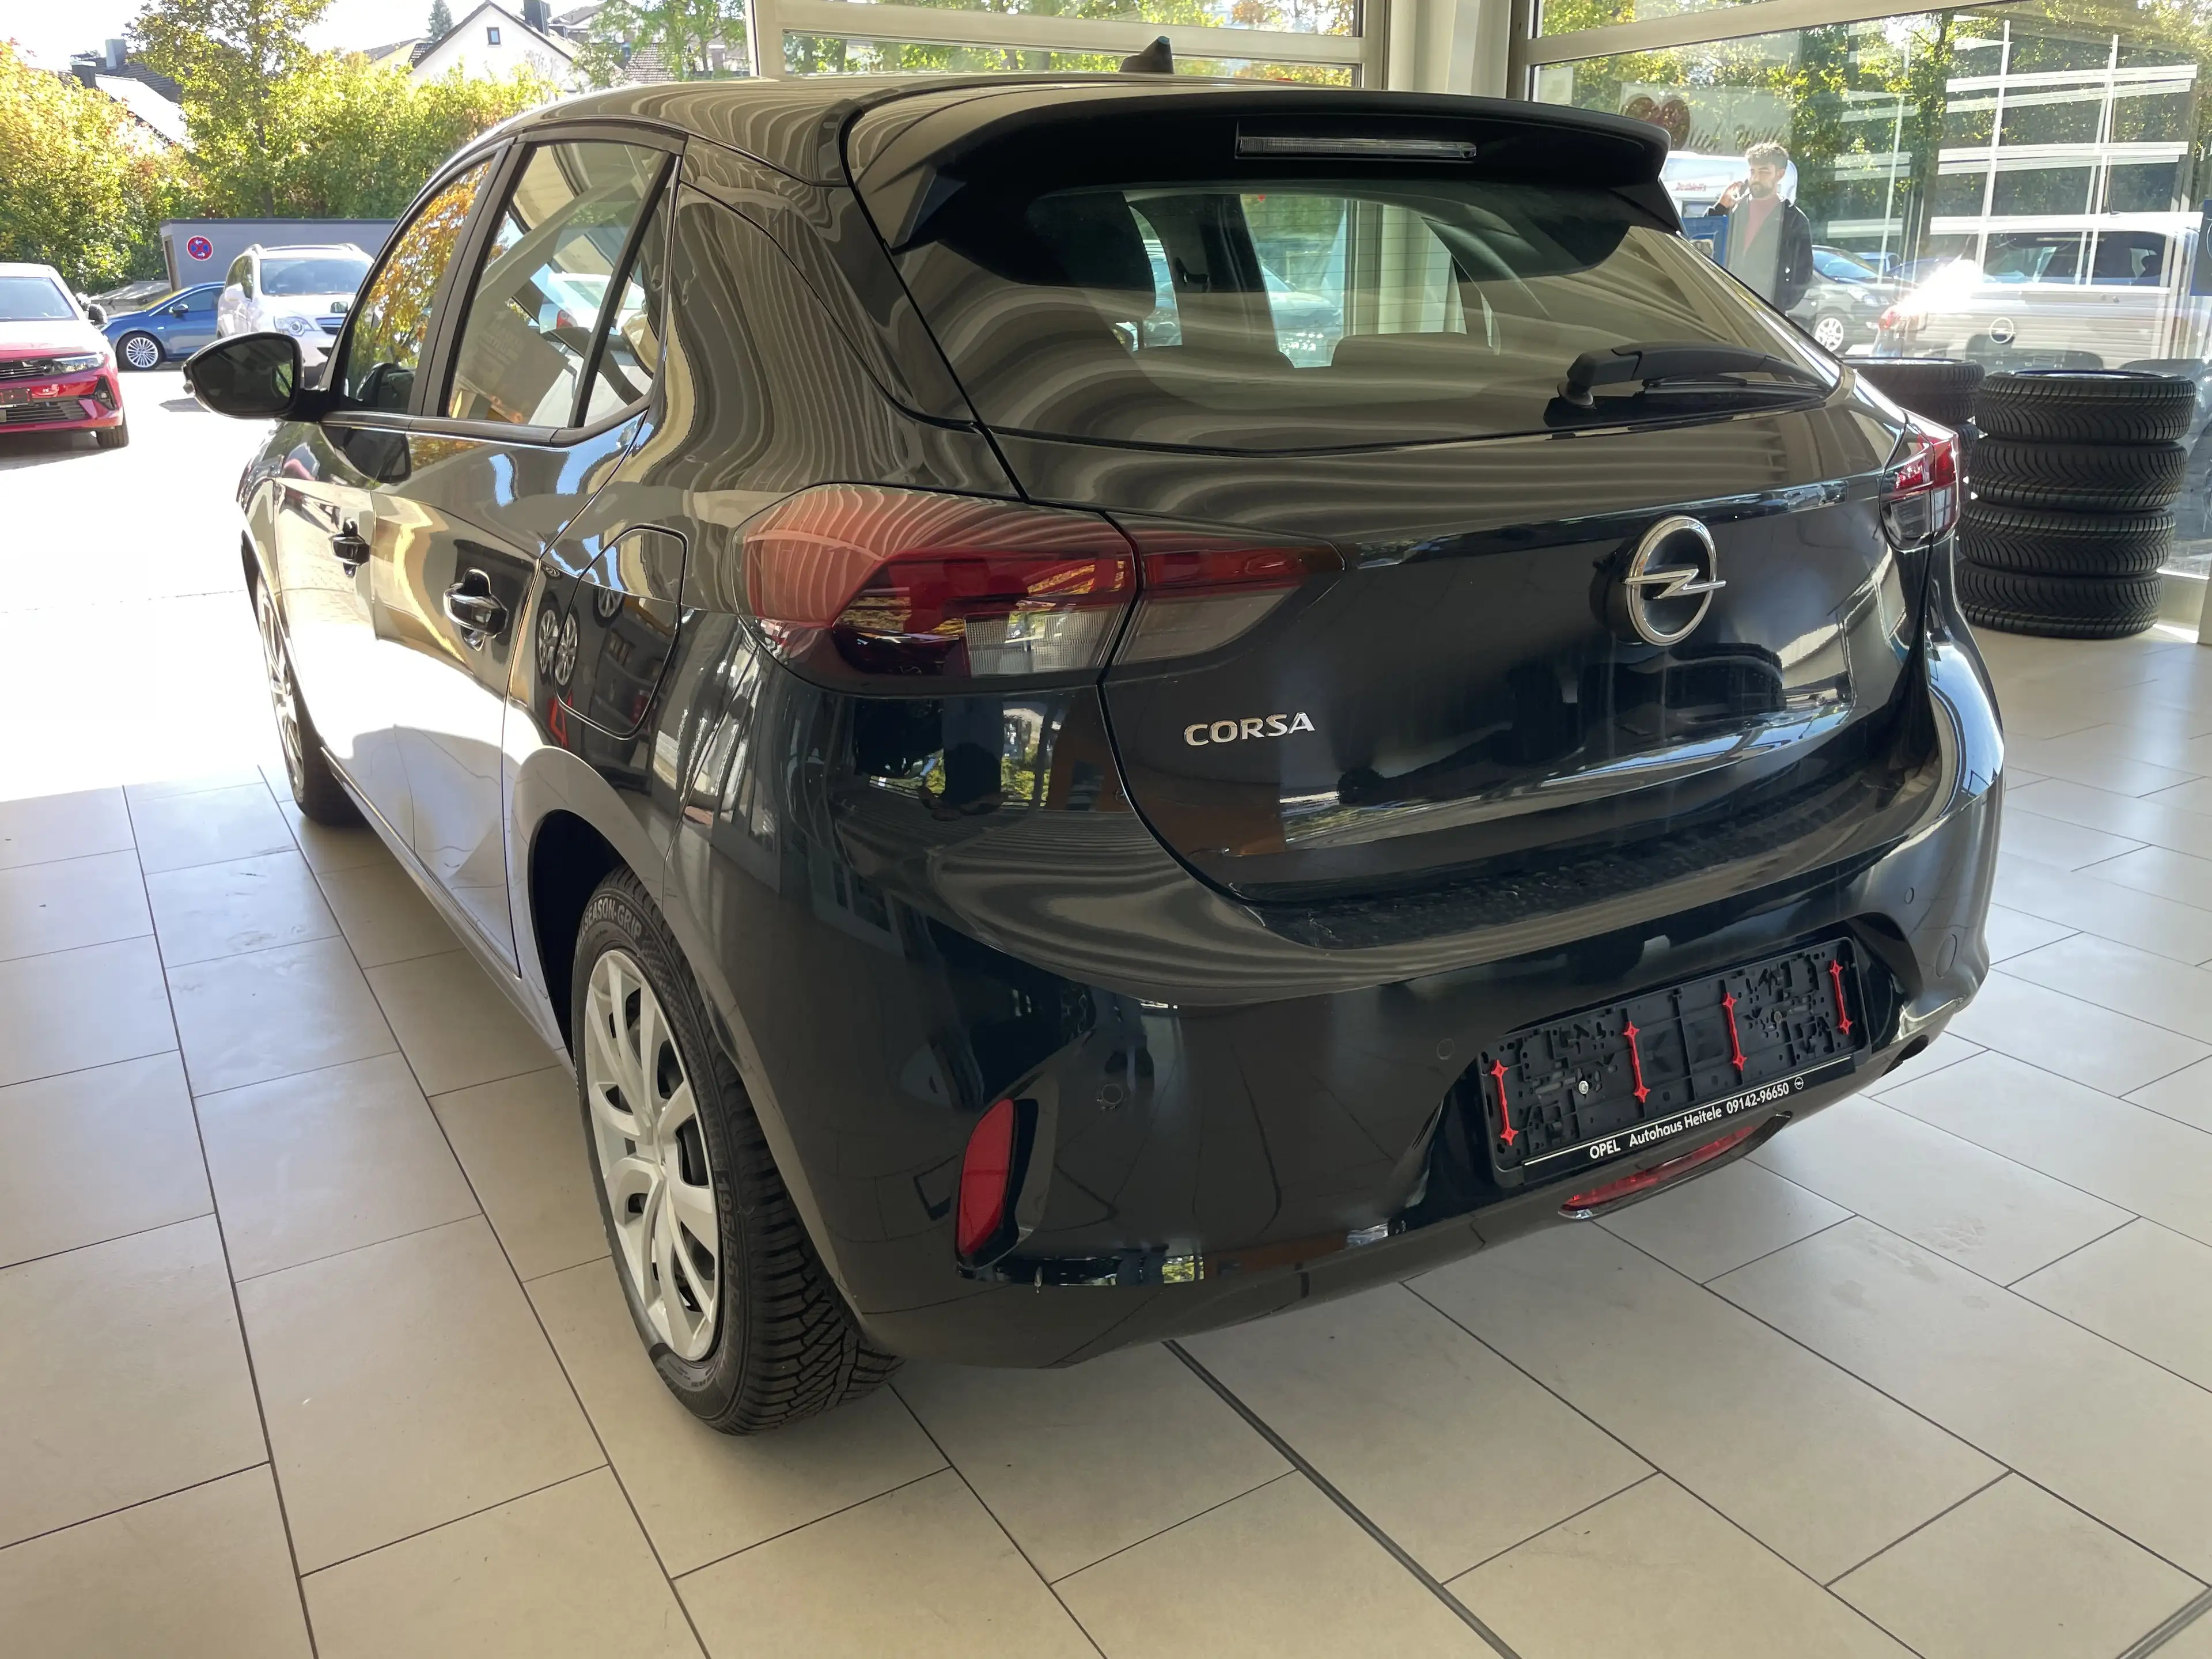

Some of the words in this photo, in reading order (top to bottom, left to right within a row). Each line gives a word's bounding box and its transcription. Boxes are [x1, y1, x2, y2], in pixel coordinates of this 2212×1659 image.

[1184, 711, 1316, 747] CORSA
[1589, 1139, 1621, 1160] OPEL
[1628, 1120, 1683, 1147] Autohaus
[1684, 1105, 1722, 1129] Heitele
[1726, 1082, 1790, 1115] 09142-96650
[717, 1177, 739, 1278] 195/55
